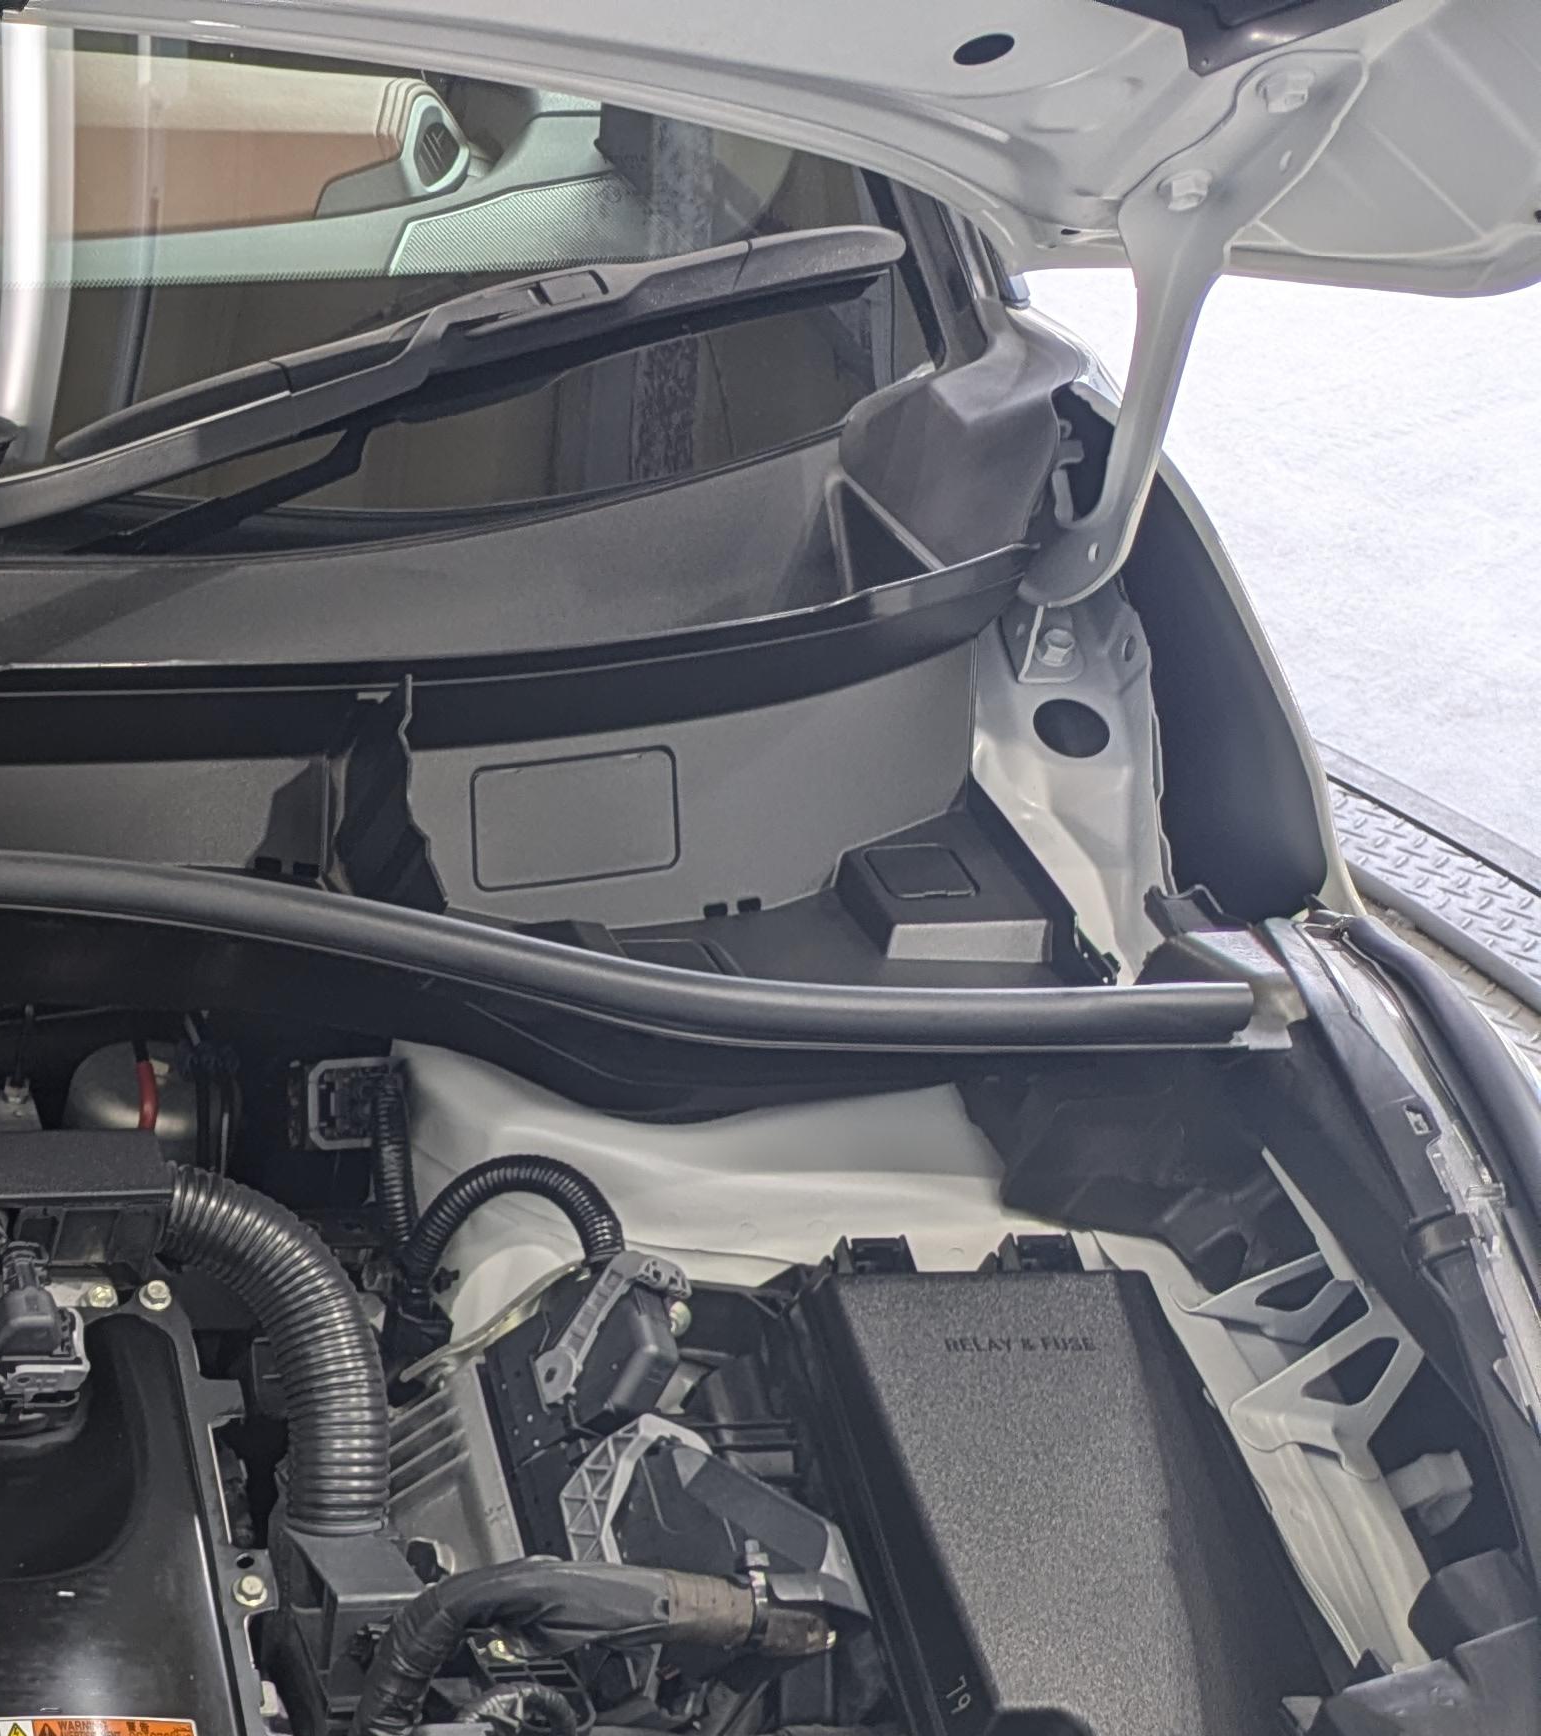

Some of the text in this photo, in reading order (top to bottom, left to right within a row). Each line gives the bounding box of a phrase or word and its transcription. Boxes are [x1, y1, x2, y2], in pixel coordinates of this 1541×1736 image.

[944, 1336, 1096, 1351] RELAY & FUSE
